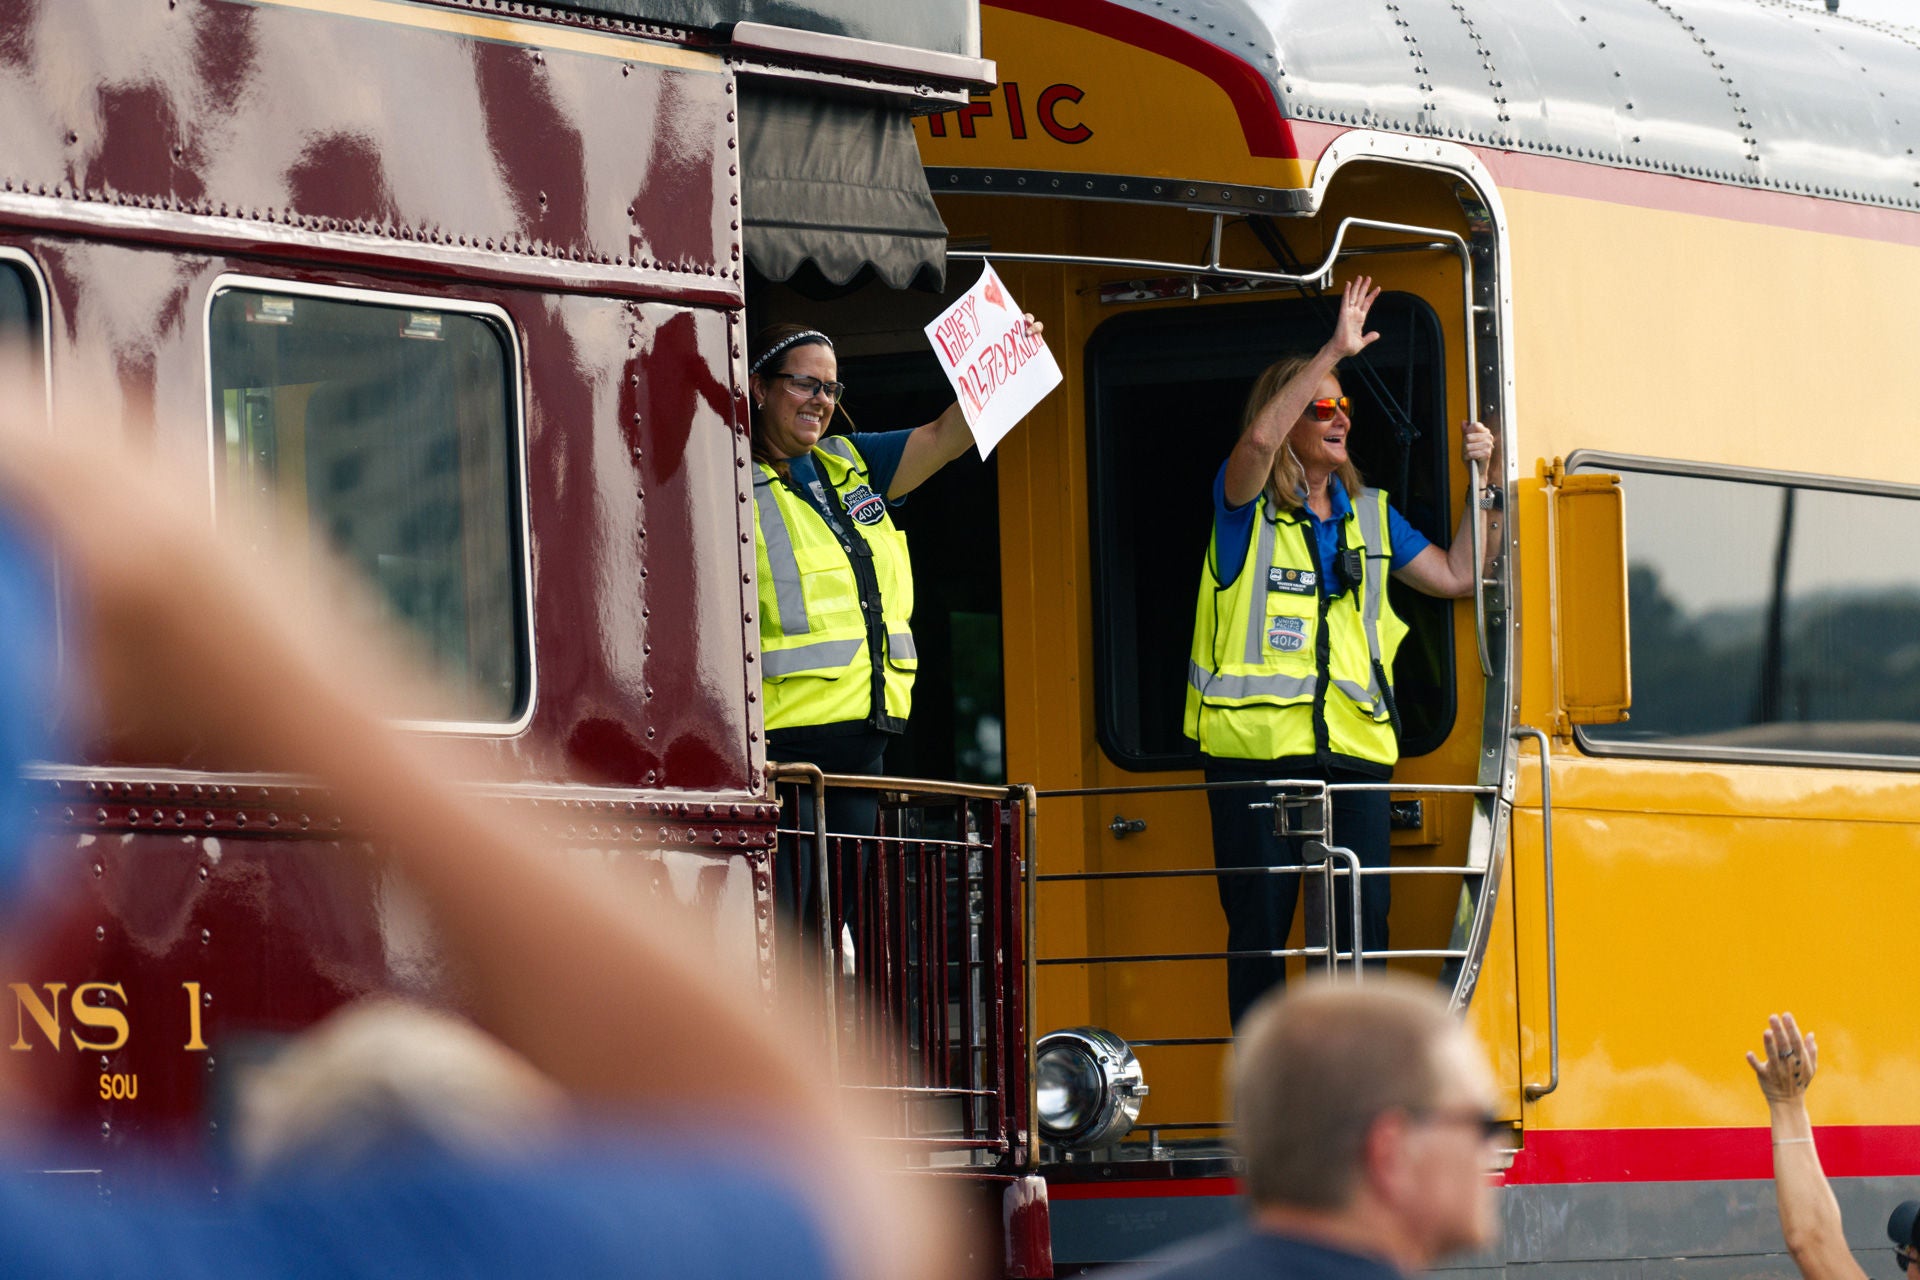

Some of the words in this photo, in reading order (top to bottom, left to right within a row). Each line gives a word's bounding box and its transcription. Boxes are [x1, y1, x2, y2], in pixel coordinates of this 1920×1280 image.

[935, 294, 981, 368] HEY
[847, 488, 865, 501] UNION
[849, 492, 870, 506] PACIFIC
[858, 502, 882, 521] 4014
[1271, 635, 1300, 648] 4014
[8, 981, 130, 1052] NS
[182, 981, 208, 1051] 1
[100, 1073, 138, 1100] SOU
